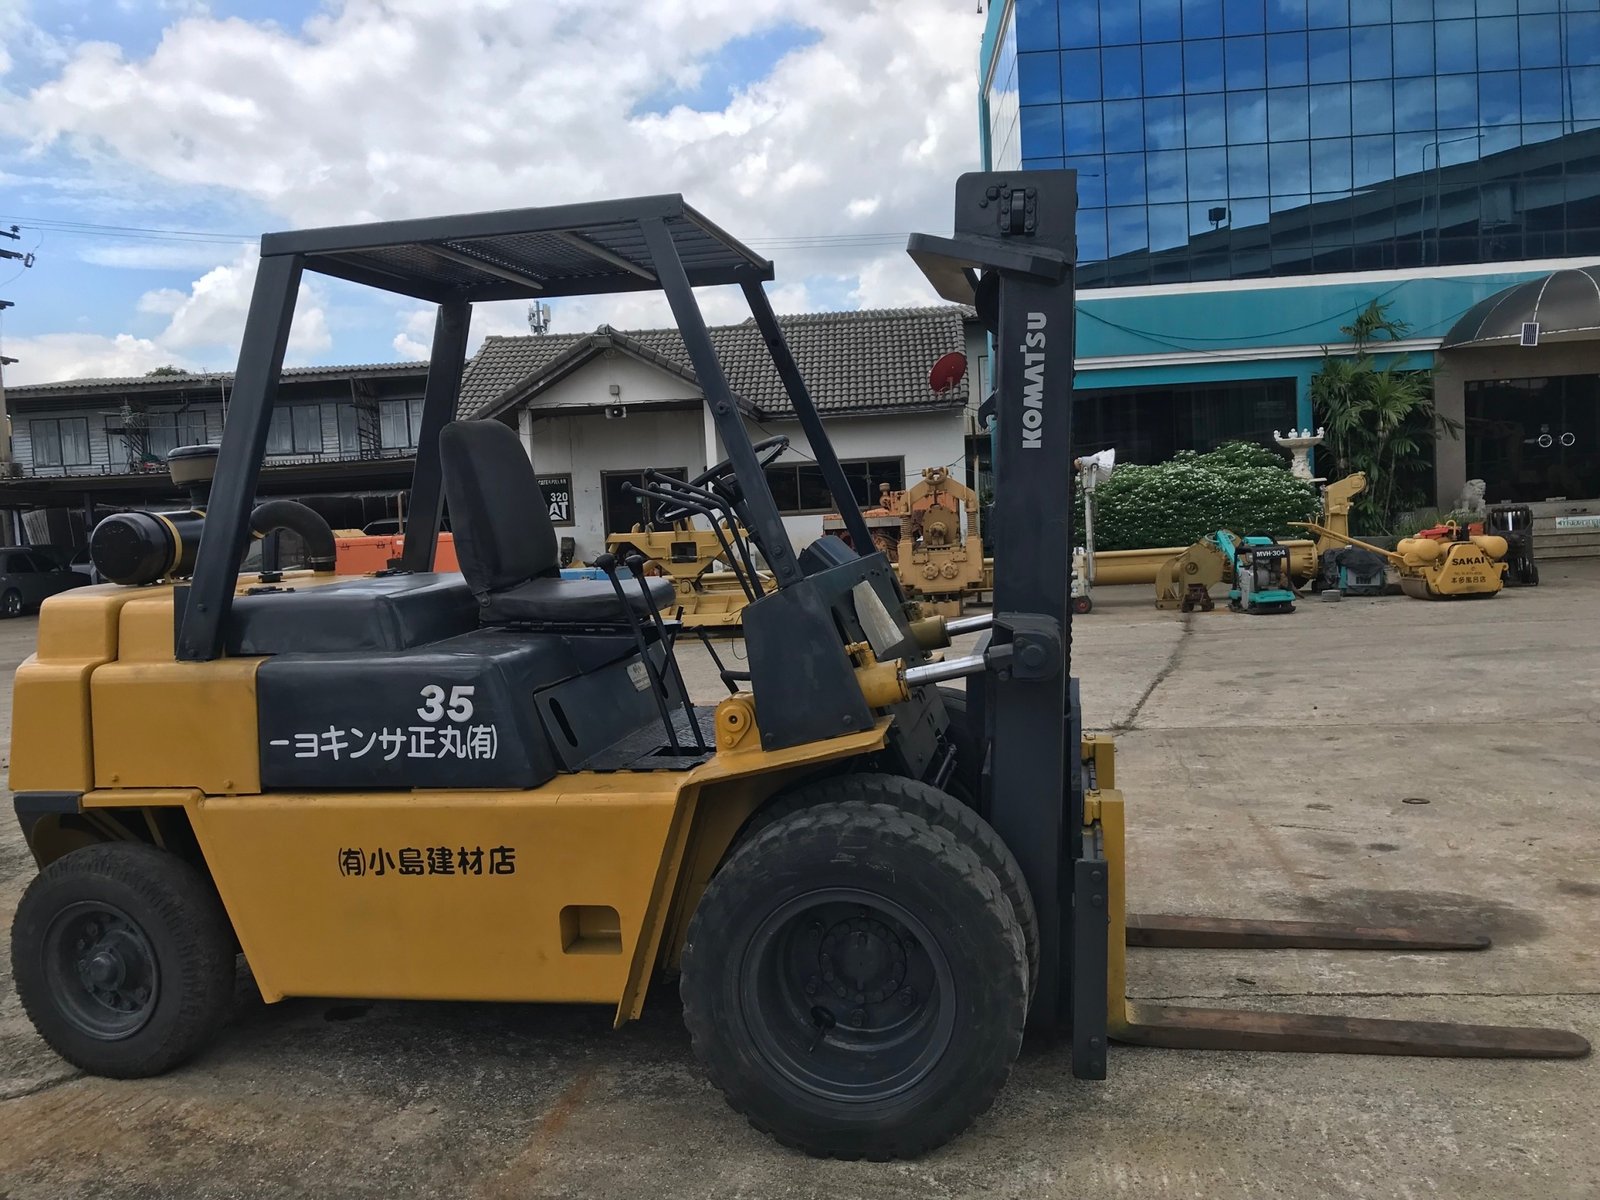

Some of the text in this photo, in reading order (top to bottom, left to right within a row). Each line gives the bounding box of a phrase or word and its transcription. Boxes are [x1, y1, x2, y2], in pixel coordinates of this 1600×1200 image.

[1020, 312, 1047, 448] KOMATSU
[550, 492, 568, 502] 320
[549, 501, 569, 520] AT
[1256, 549, 1286, 558] MVH-304
[1451, 556, 1485, 566] SAKAI
[416, 684, 475, 723] 35
